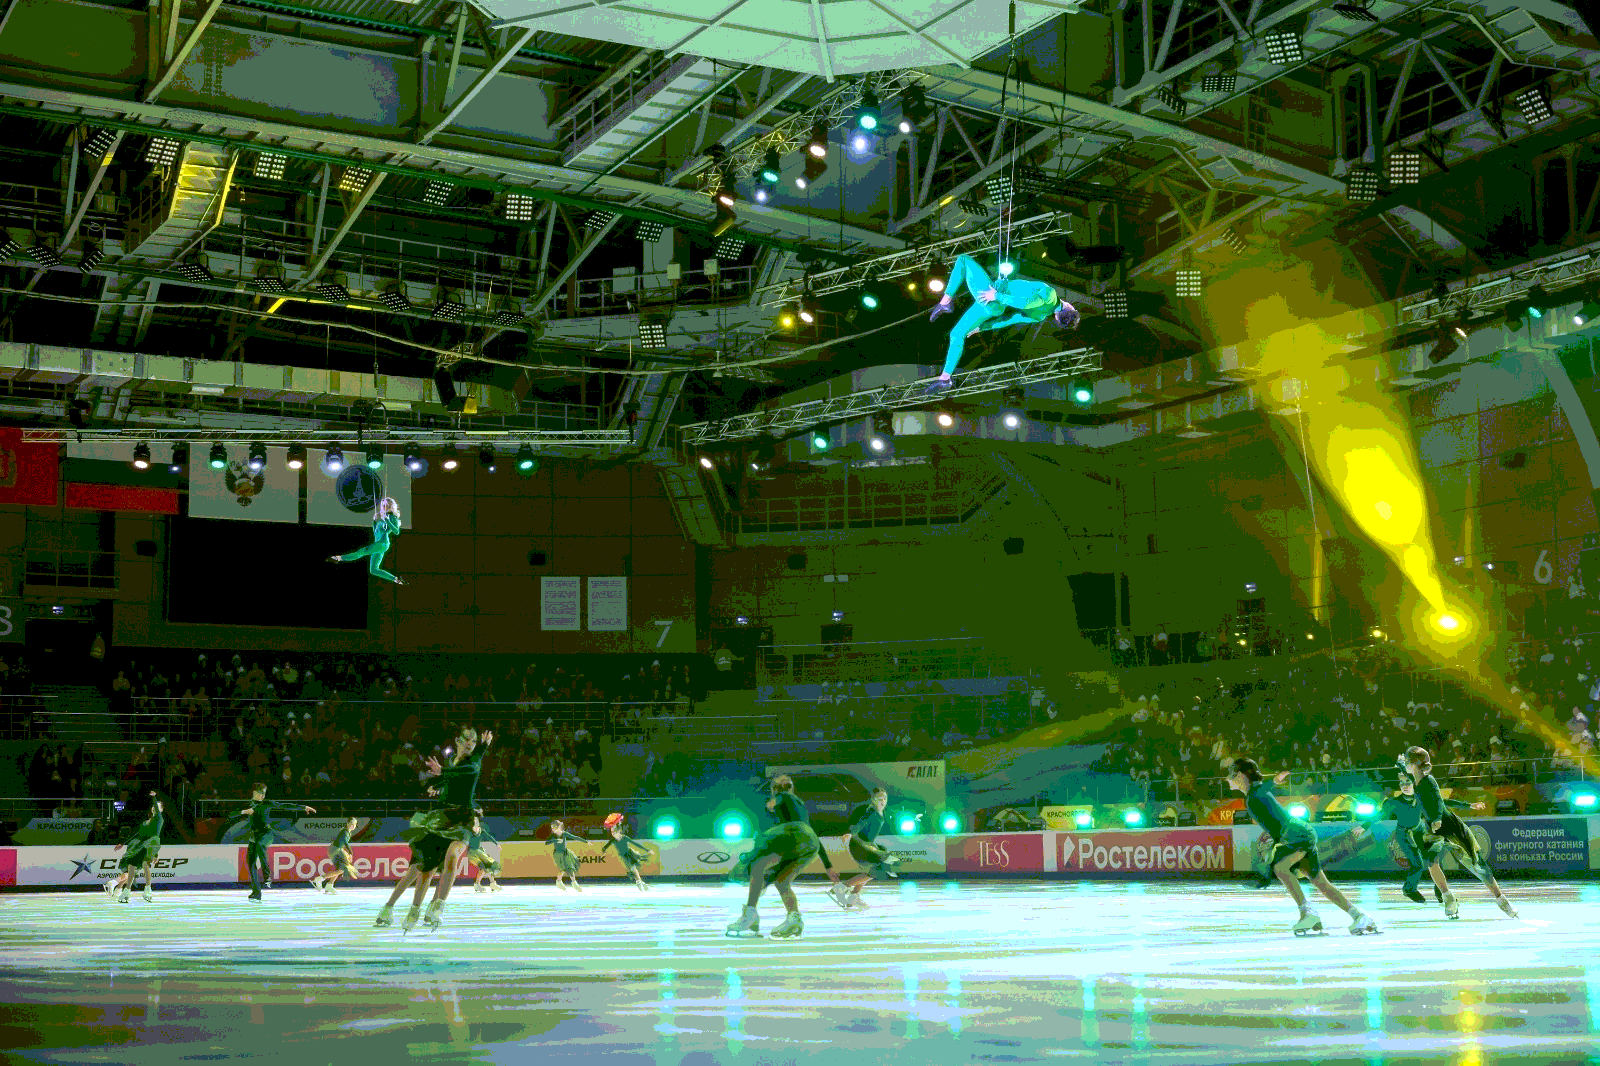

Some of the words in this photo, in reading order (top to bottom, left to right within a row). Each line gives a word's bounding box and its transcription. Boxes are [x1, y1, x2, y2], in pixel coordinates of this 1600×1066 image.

[1533, 549, 1553, 585] 6
[654, 620, 673, 648] 7
[1511, 827, 1565, 839] Федерация
[977, 839, 1010, 868] TESS
[1078, 838, 1226, 869] Ростелеком
[1494, 839, 1544, 852] фигурного
[1546, 840, 1584, 849] катания
[1496, 852, 1509, 861] на
[1509, 852, 1546, 861] коньках
[1548, 850, 1584, 861] России
[99, 858, 189, 870] СЕР
